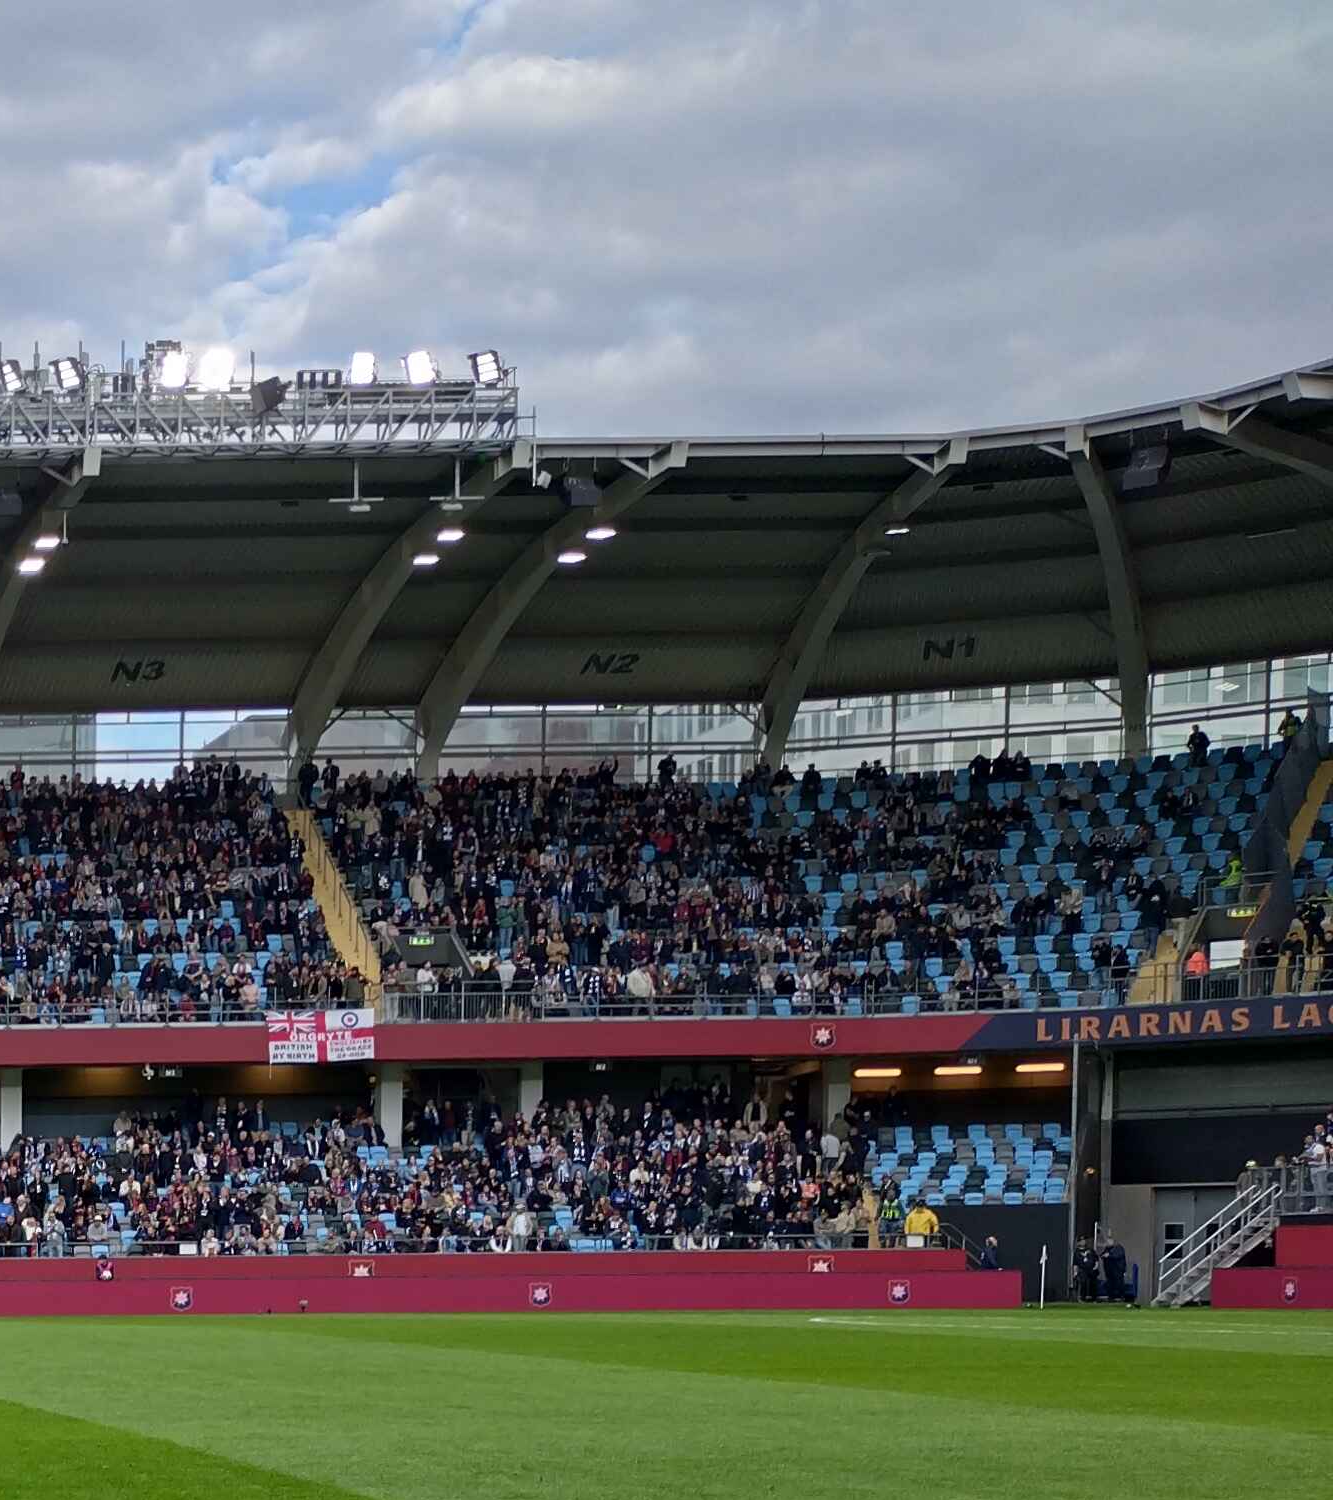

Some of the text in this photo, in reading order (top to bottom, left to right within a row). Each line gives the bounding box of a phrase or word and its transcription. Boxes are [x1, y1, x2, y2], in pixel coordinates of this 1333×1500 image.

[923, 638, 975, 660] N1
[111, 660, 166, 682] N3
[580, 654, 640, 675] N2
[1036, 1002, 1333, 1042] LIRARNAS LA
